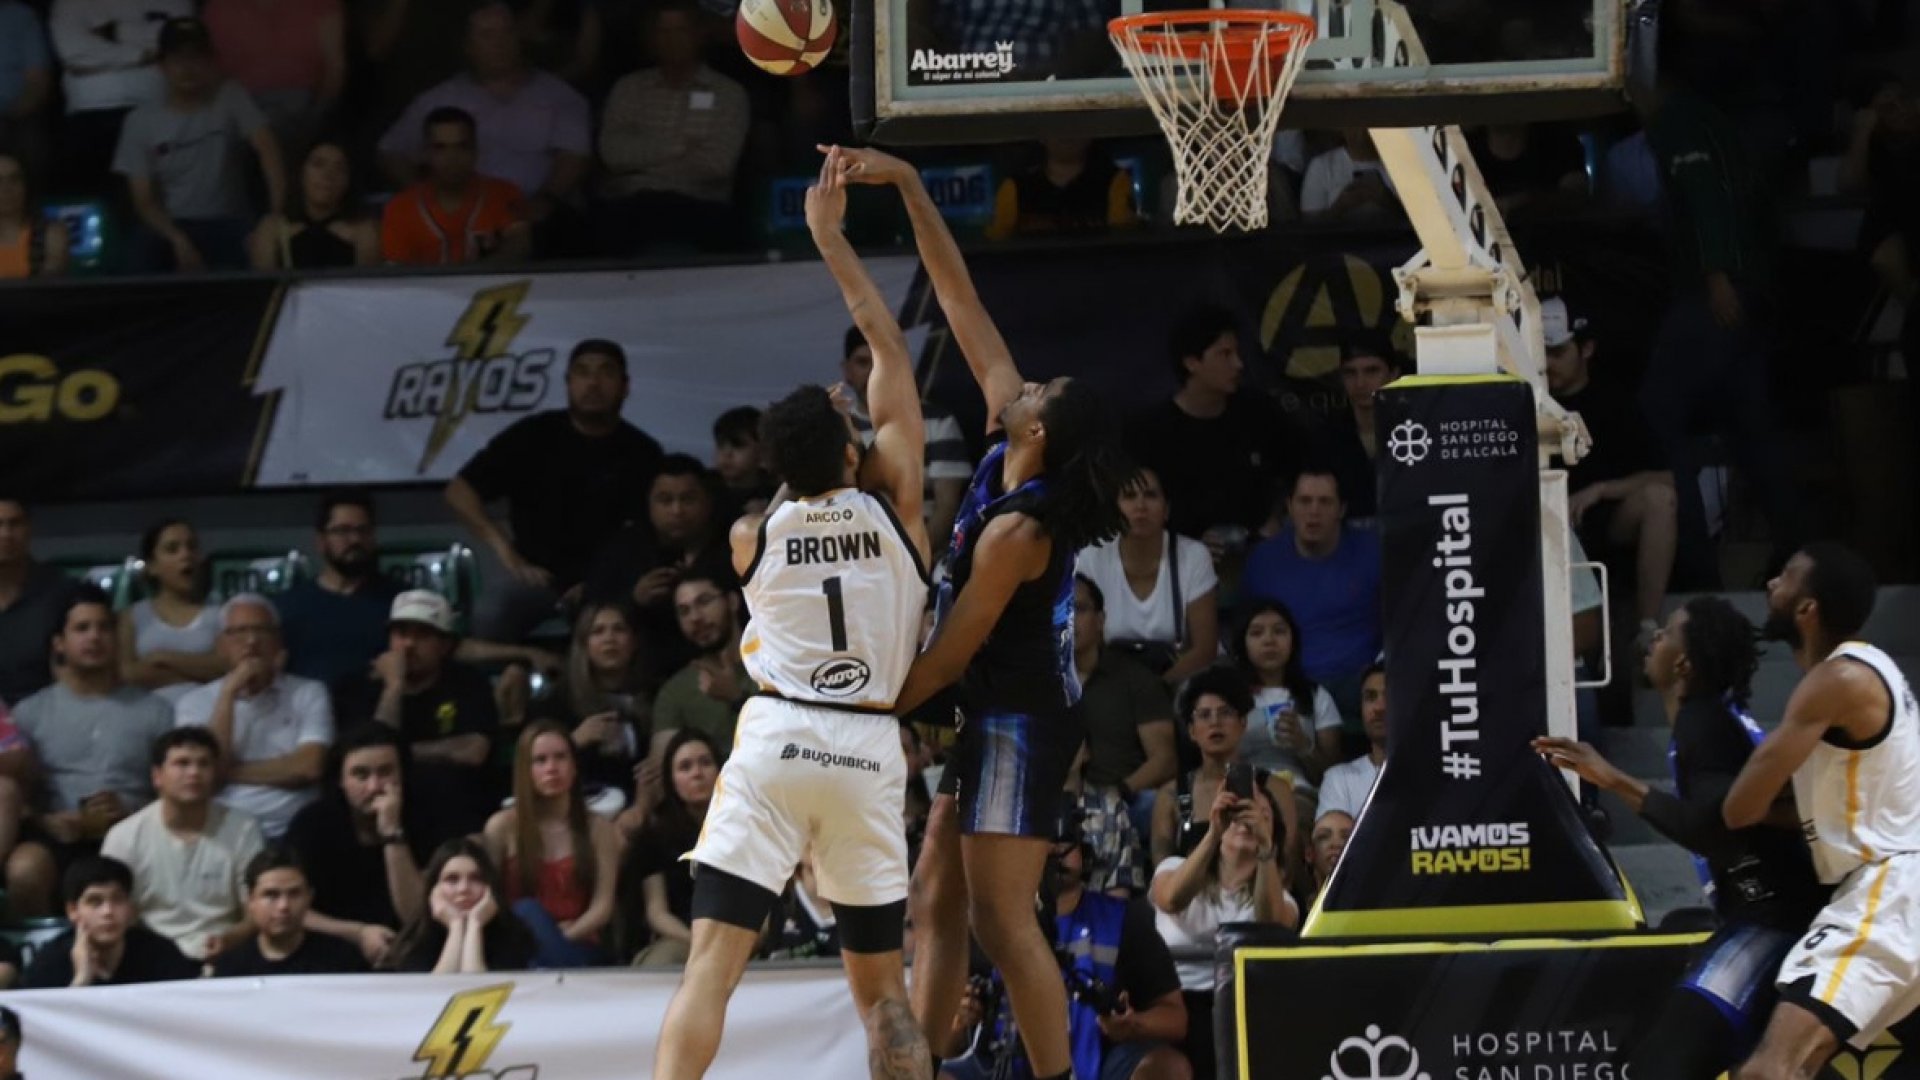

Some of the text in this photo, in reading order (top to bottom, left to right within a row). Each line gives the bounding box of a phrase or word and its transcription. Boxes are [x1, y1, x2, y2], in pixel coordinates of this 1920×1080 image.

[911, 48, 1013, 74] Abarrey
[0, 353, 122, 424] Go
[385, 348, 555, 421] RAYOS
[1439, 418, 1509, 432] HOSPITAL
[1440, 430, 1520, 446] SAN DIEGO
[1441, 442, 1519, 460] DE ALCALÁ
[805, 510, 841, 524] ARCO
[786, 531, 882, 567] BROWN
[822, 576, 848, 653] 1
[1427, 492, 1486, 781] #TuHospital
[801, 750, 881, 773] BUQUIBICHI
[1410, 846, 1532, 876] RAYOS!
[1451, 1029, 1618, 1057] HOSPITAL
[1455, 1064, 1521, 1080] SAN
